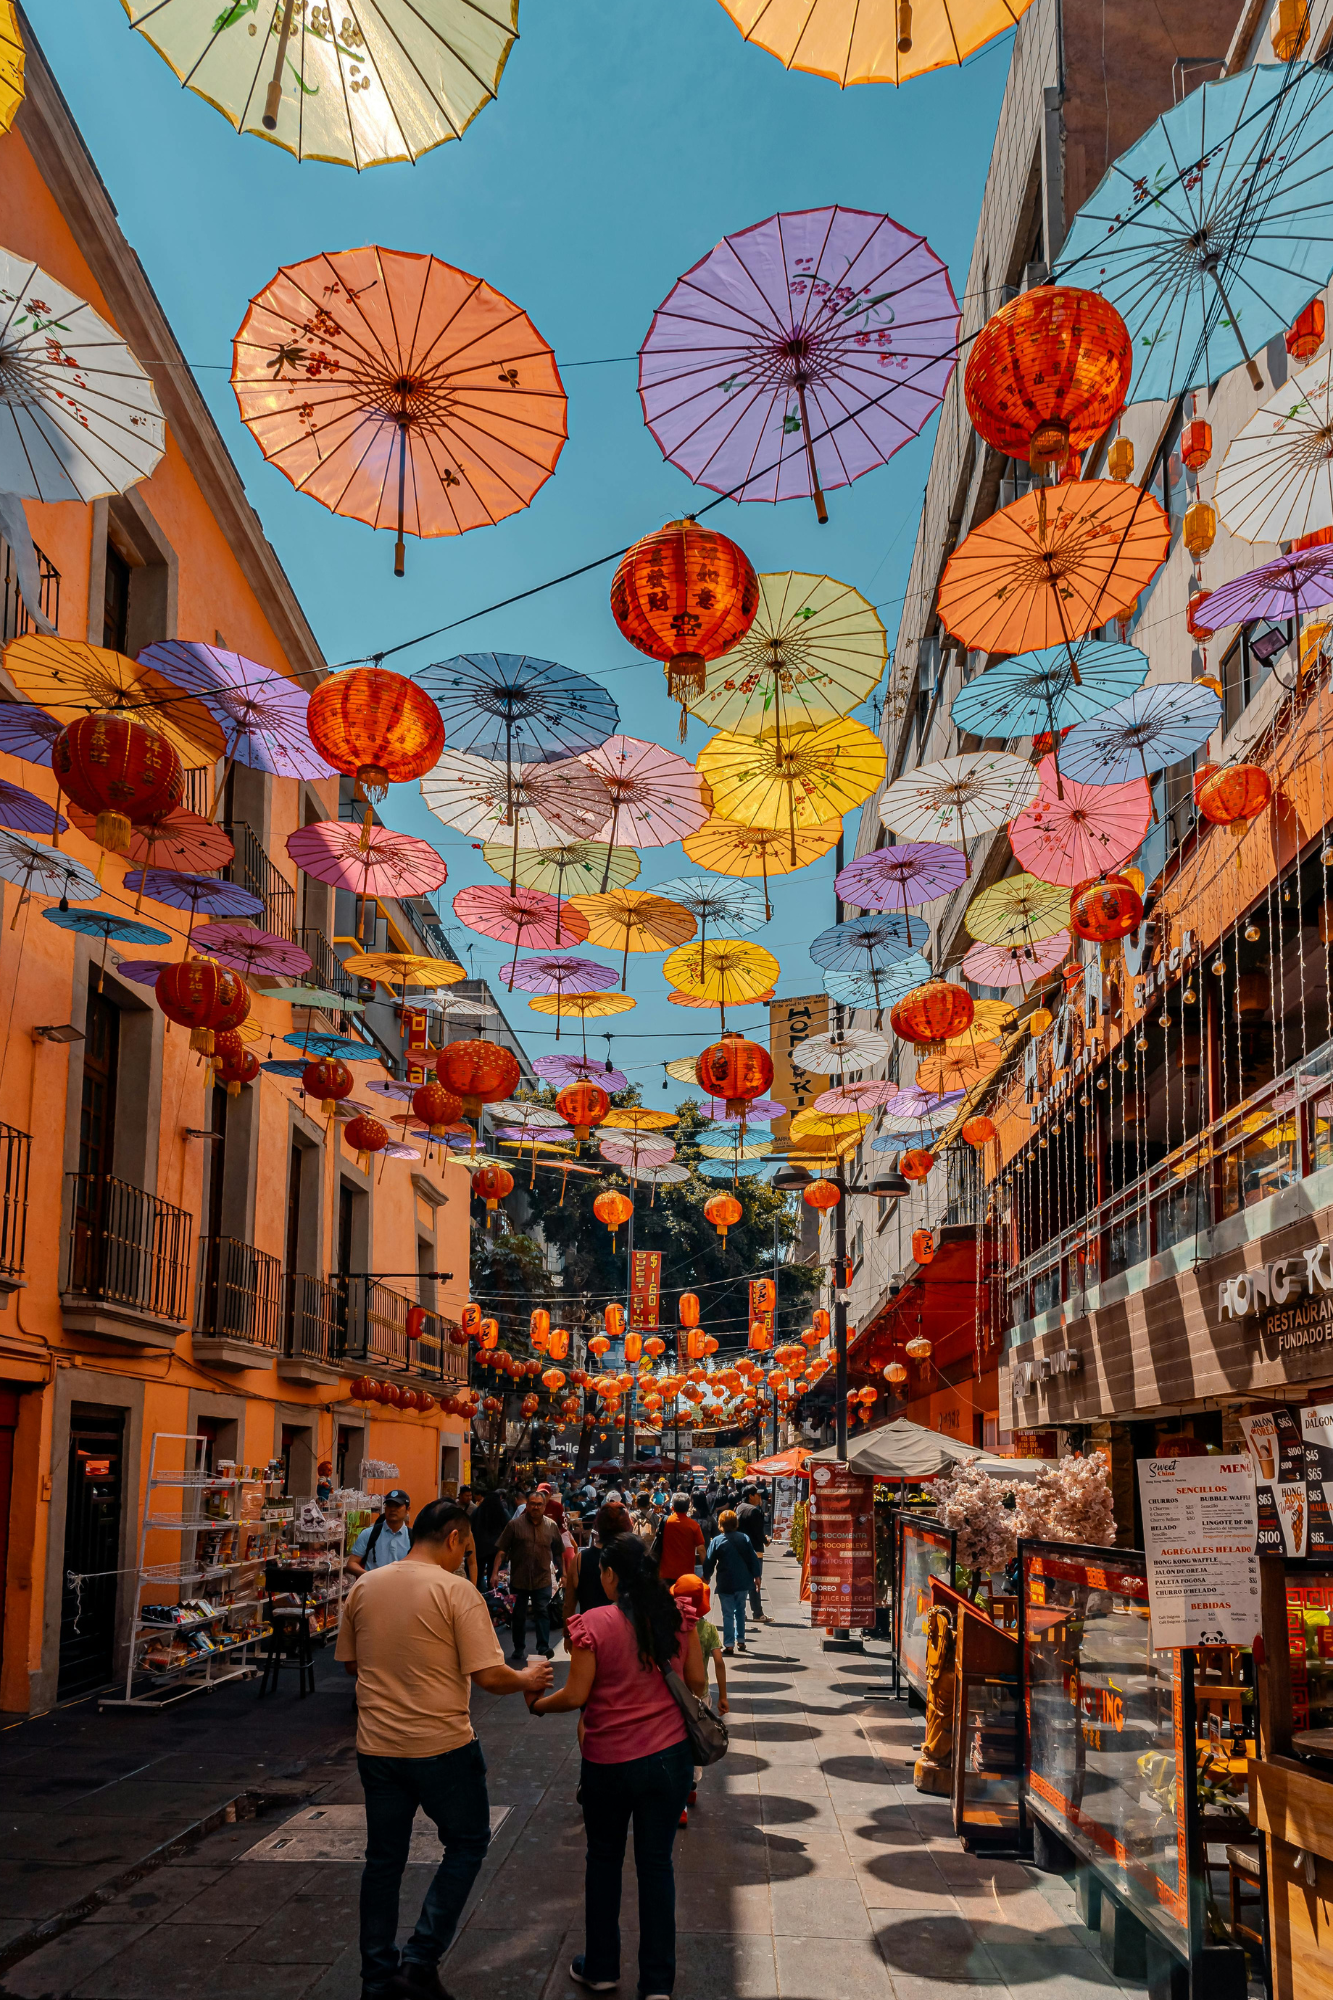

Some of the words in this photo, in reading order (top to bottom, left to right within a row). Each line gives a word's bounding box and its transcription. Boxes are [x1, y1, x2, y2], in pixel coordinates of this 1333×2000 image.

[1218, 1258, 1291, 1322] HONG
[1279, 1326, 1323, 1351] FUNDADO
[1306, 1449, 1319, 1462] $45
[1148, 1459, 1180, 1478] Sweet
[1307, 1467, 1322, 1481] $65
[1177, 1486, 1227, 1494] SENCILLOS
[1281, 1486, 1302, 1498] HONG
[1308, 1490, 1322, 1502] $65
[1258, 1493, 1272, 1505] $65
[1258, 1530, 1280, 1544] $100
[1310, 1532, 1324, 1544] $65
[1161, 1546, 1214, 1556] AGRÉGALES
[1154, 1568, 1176, 1576] JALÓN
[1191, 1602, 1231, 1610] BEBIDAS
